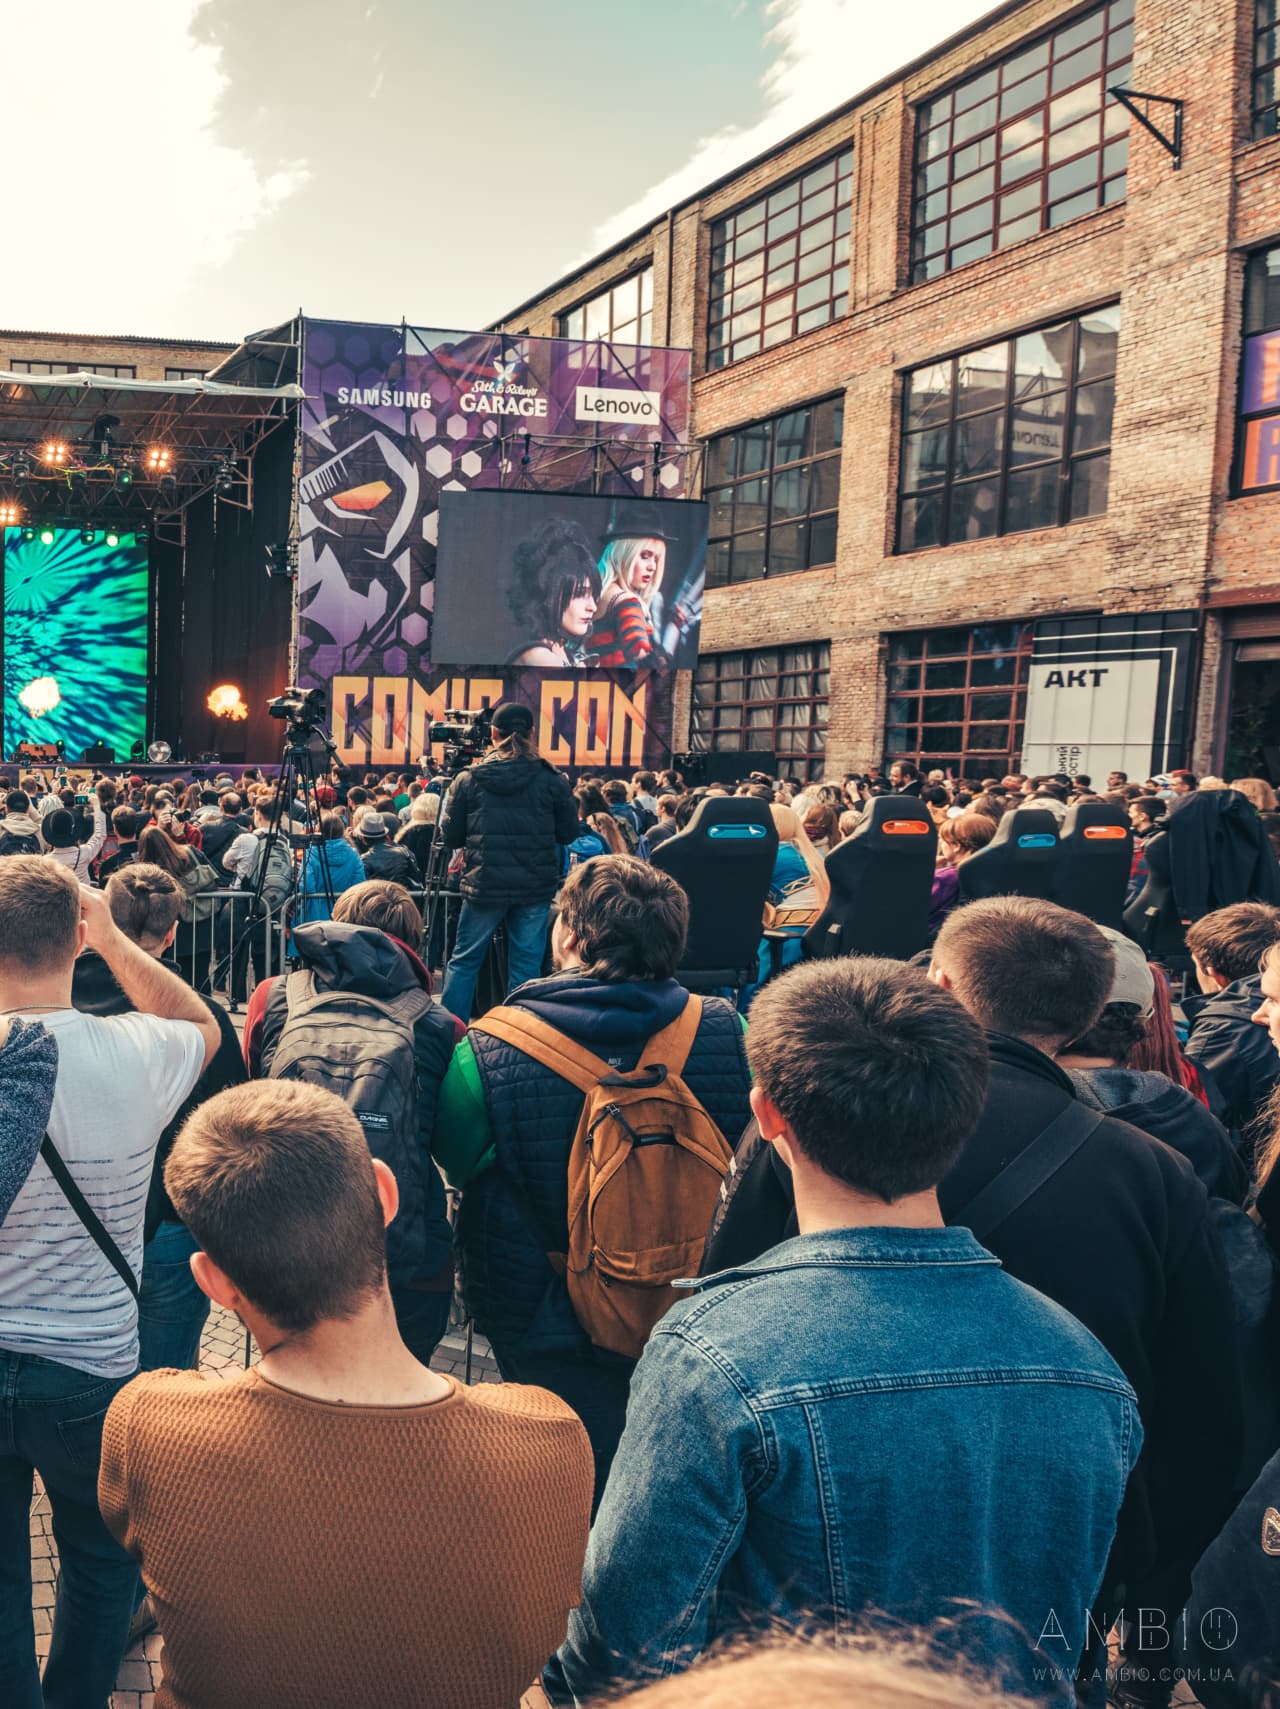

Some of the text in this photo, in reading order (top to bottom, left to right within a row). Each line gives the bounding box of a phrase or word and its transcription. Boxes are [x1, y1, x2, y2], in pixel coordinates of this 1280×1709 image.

[337, 386, 432, 409] SAMSUNG
[459, 392, 549, 418] GARAGE
[583, 394, 653, 416] Lenovo
[538, 680, 647, 767] CON
